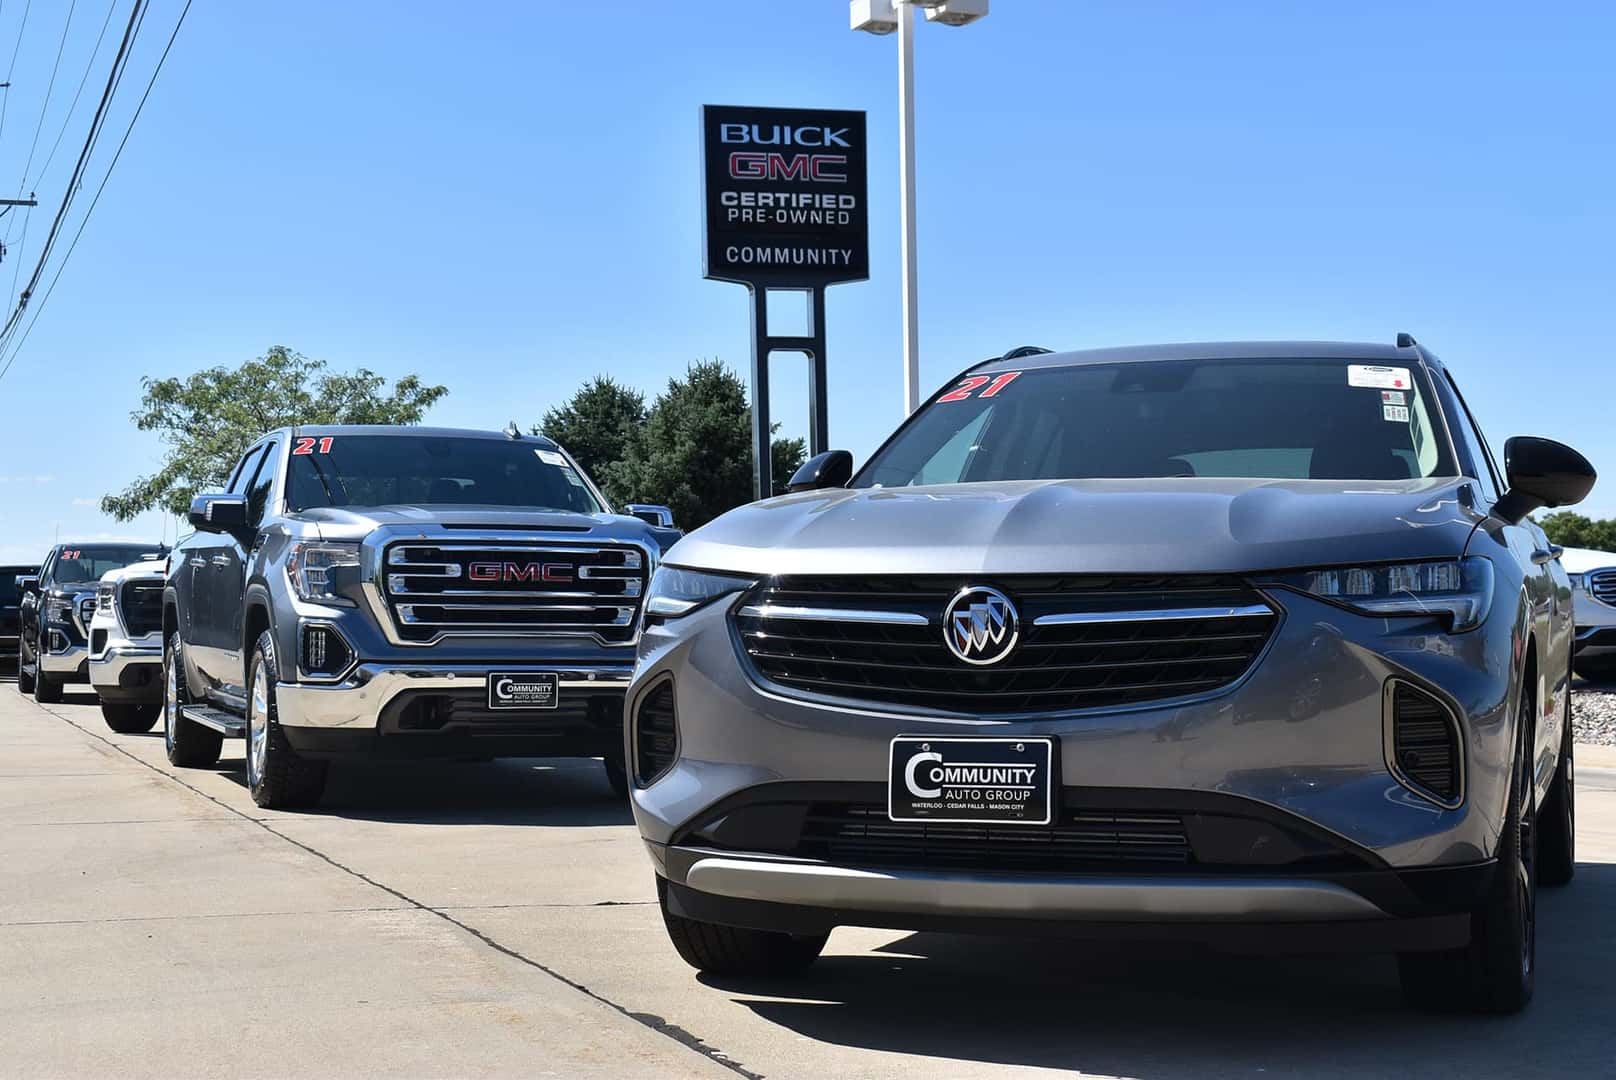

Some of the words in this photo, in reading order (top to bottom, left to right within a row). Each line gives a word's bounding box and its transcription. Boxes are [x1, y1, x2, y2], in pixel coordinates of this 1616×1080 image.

[720, 123, 851, 147] BUICK
[729, 151, 847, 182] GMC
[720, 191, 856, 209] CERTIFIED
[728, 208, 850, 224] PRE-OWNED
[726, 246, 851, 265] COMMUNITY
[935, 371, 1023, 403] 21
[293, 437, 334, 455] 21
[469, 561, 574, 582] GMC
[496, 679, 553, 699] COMMUNITY
[904, 752, 1036, 798] COMMUNITY
[945, 790, 981, 801] AUTO
[985, 790, 1031, 801] GROUP
